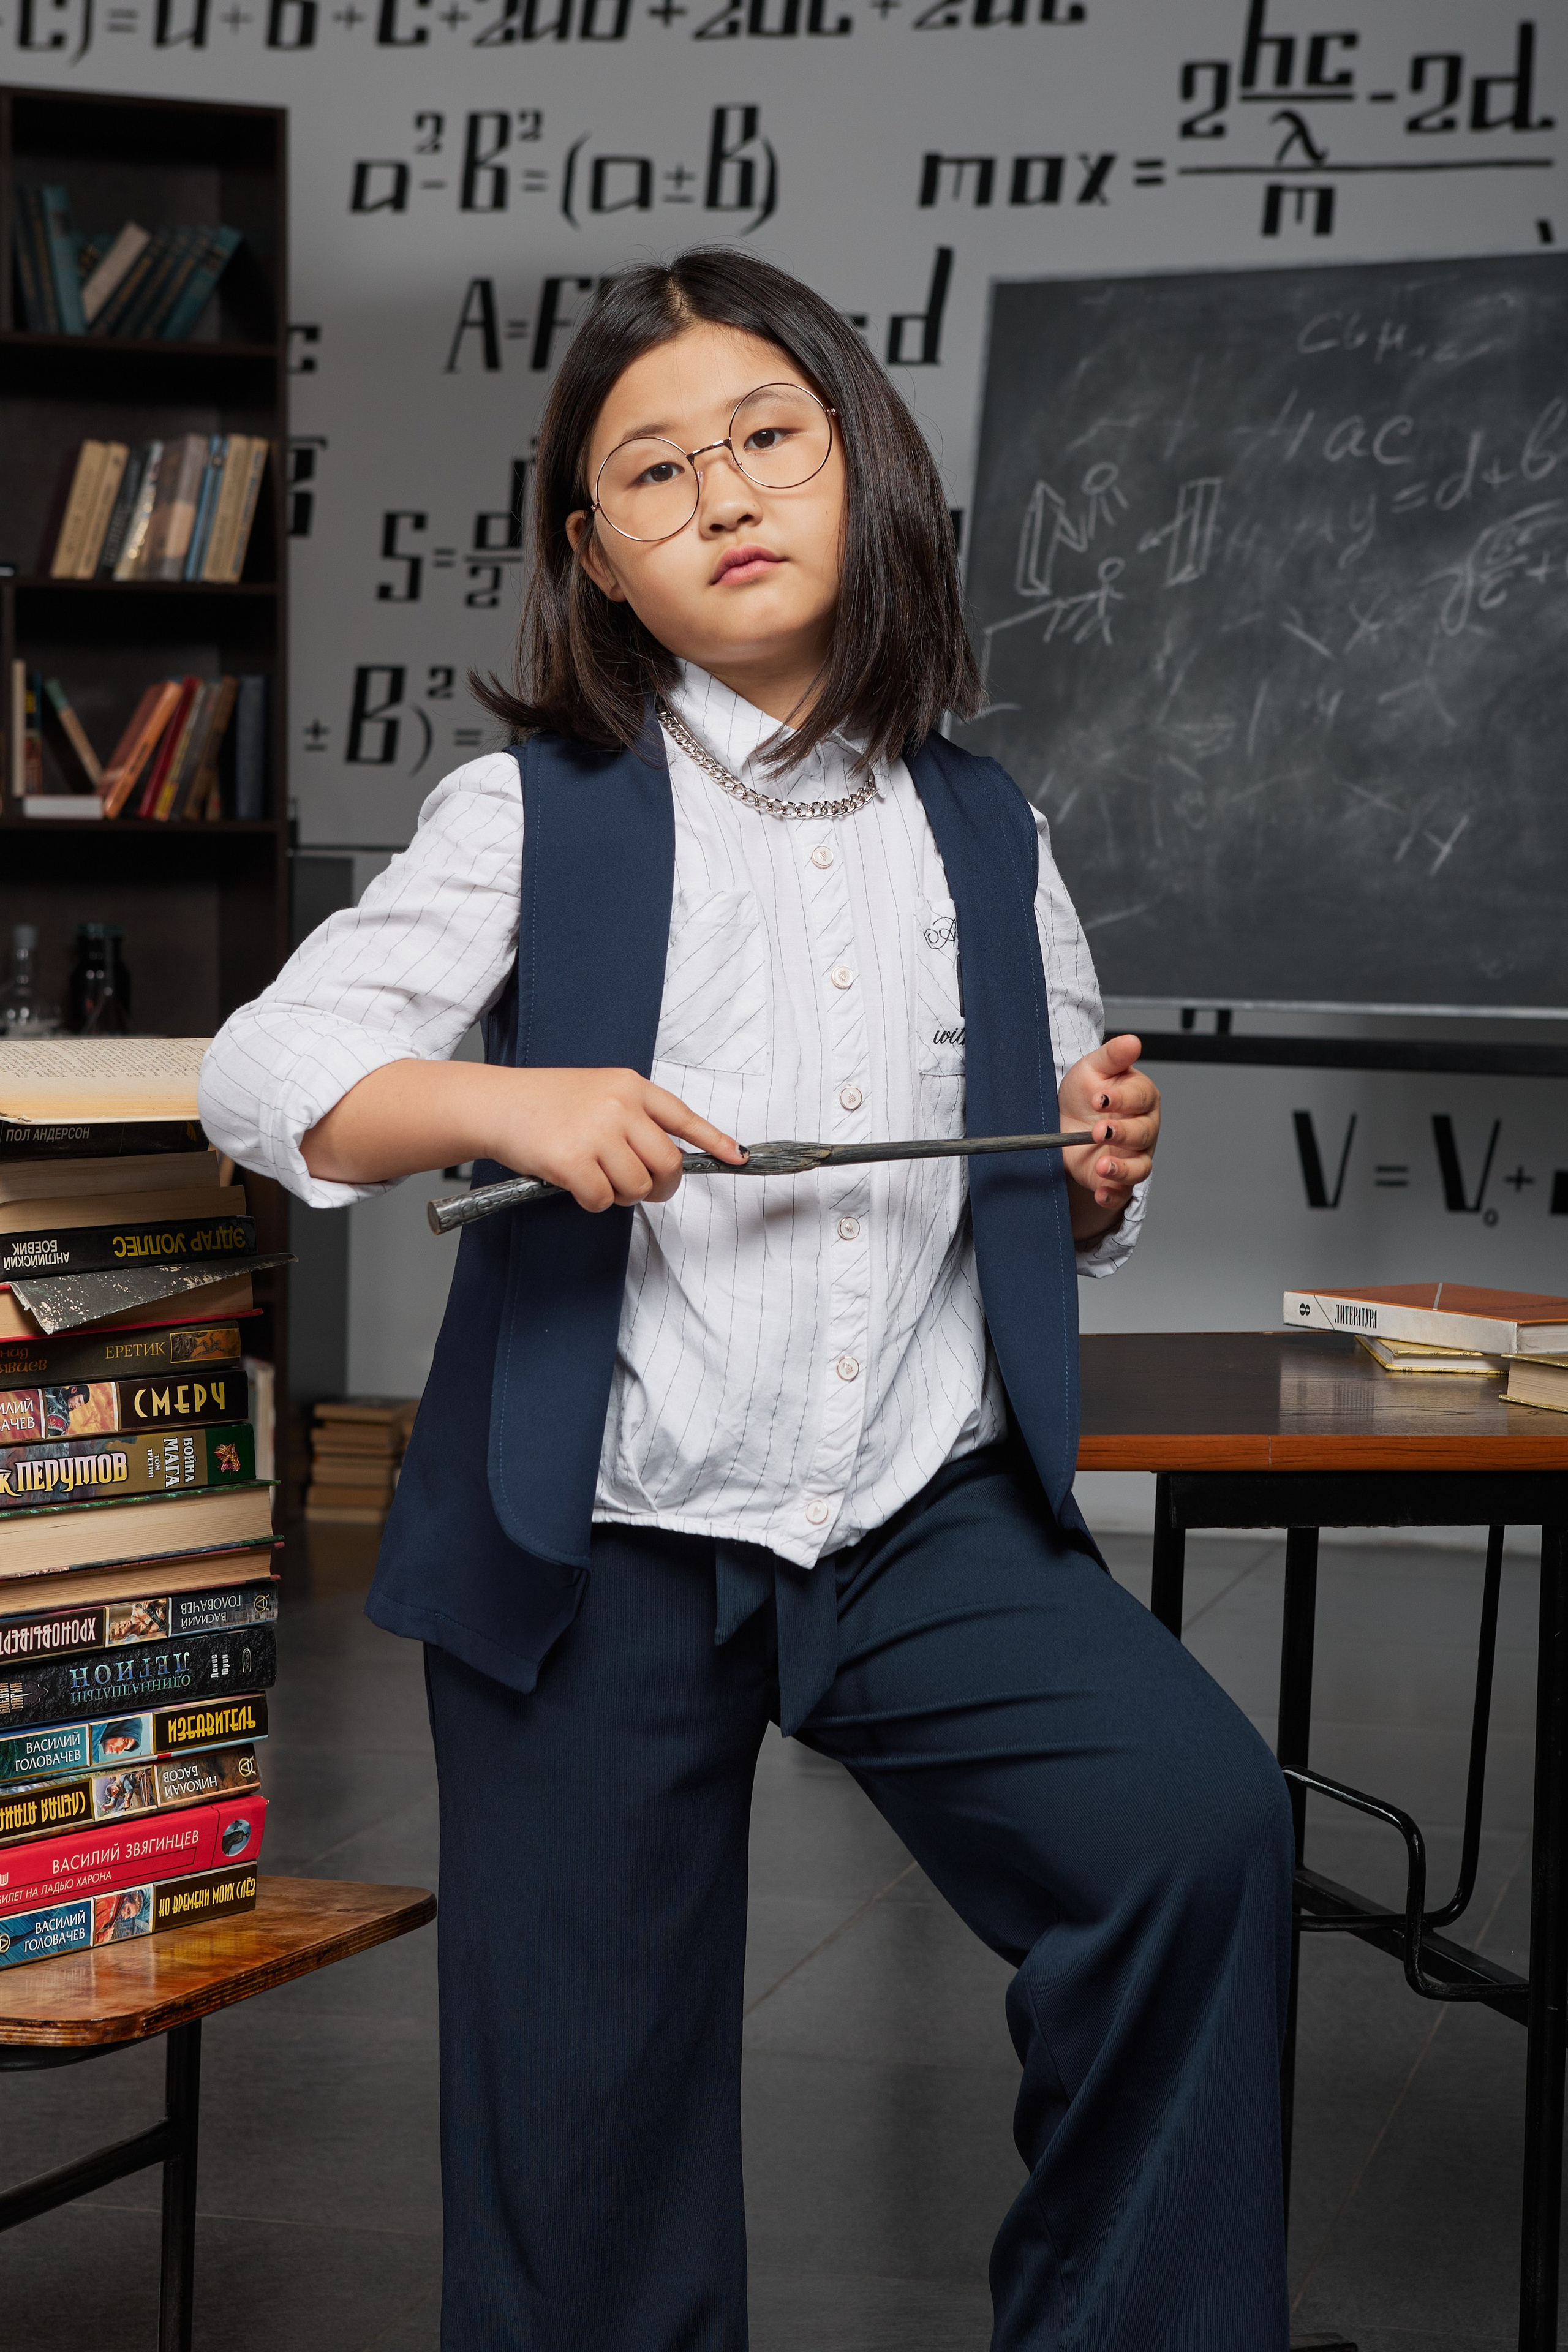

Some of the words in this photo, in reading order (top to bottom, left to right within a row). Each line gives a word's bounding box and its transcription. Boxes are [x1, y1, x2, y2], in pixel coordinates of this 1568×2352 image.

[6, 1128, 30, 1142] ПОЛ
[32, 1126, 91, 1142] АНДЕРСОН
[12, 1240, 58, 1255] БОЕВИК
[112, 1233, 186, 1258] УОЛЛЕС
[190, 1226, 246, 1251] ЭДГАР
[3, 1251, 70, 1270] АНГЛИЙСКИЙ
[1335, 1304, 1378, 1329] ЛИТЕРАТУРА
[105, 1341, 165, 1360] ЕРЕТИК
[134, 1382, 225, 1418] СМЕРЧ
[0, 1416, 35, 1431] АЧЕВ
[164, 1437, 180, 1488] МАГА
[183, 1436, 195, 1483] ВОЙНА
[14, 1452, 127, 1493] ПЕРУМОВ
[181, 1595, 243, 1615] ГОЛОВАЧЕВ
[181, 1611, 227, 1631] ВАСИЛИЙ
[69, 1651, 190, 1689] ЛЕГИОН
[221, 1654, 230, 1675] Юрин
[70, 1674, 191, 1705] ОДИННАДЦАТЫЙ
[168, 1706, 256, 1743] ИЗБАВИТЕЛЬ
[26, 1732, 80, 1754] ВАСИЛИЙ
[15, 1749, 81, 1772] ГОЛОВАЧЕВ
[164, 1765, 198, 1783] БАСОВ
[164, 1776, 218, 1800] НИКОЛАЙ
[40, 1790, 86, 1823] СЛЕПАЯ
[53, 1843, 121, 1874] ВАСИЛИЙ
[125, 1830, 199, 1859] ЗВЯГИНЦЕВ
[26, 1887, 38, 1899] НА
[40, 1879, 74, 1895] ЛАДЬЮ
[76, 1871, 111, 1887] ХАРОНА
[158, 1897, 170, 1917] КО
[172, 1888, 210, 1914] ВРЕМЕНИ
[213, 1883, 235, 1905] МОИХ
[236, 1877, 256, 1899] СЛЁЗ
[36, 1910, 85, 1934] ВАСИЛИЙ
[24, 1928, 85, 1953] ГОЛОВАЧЕВ
